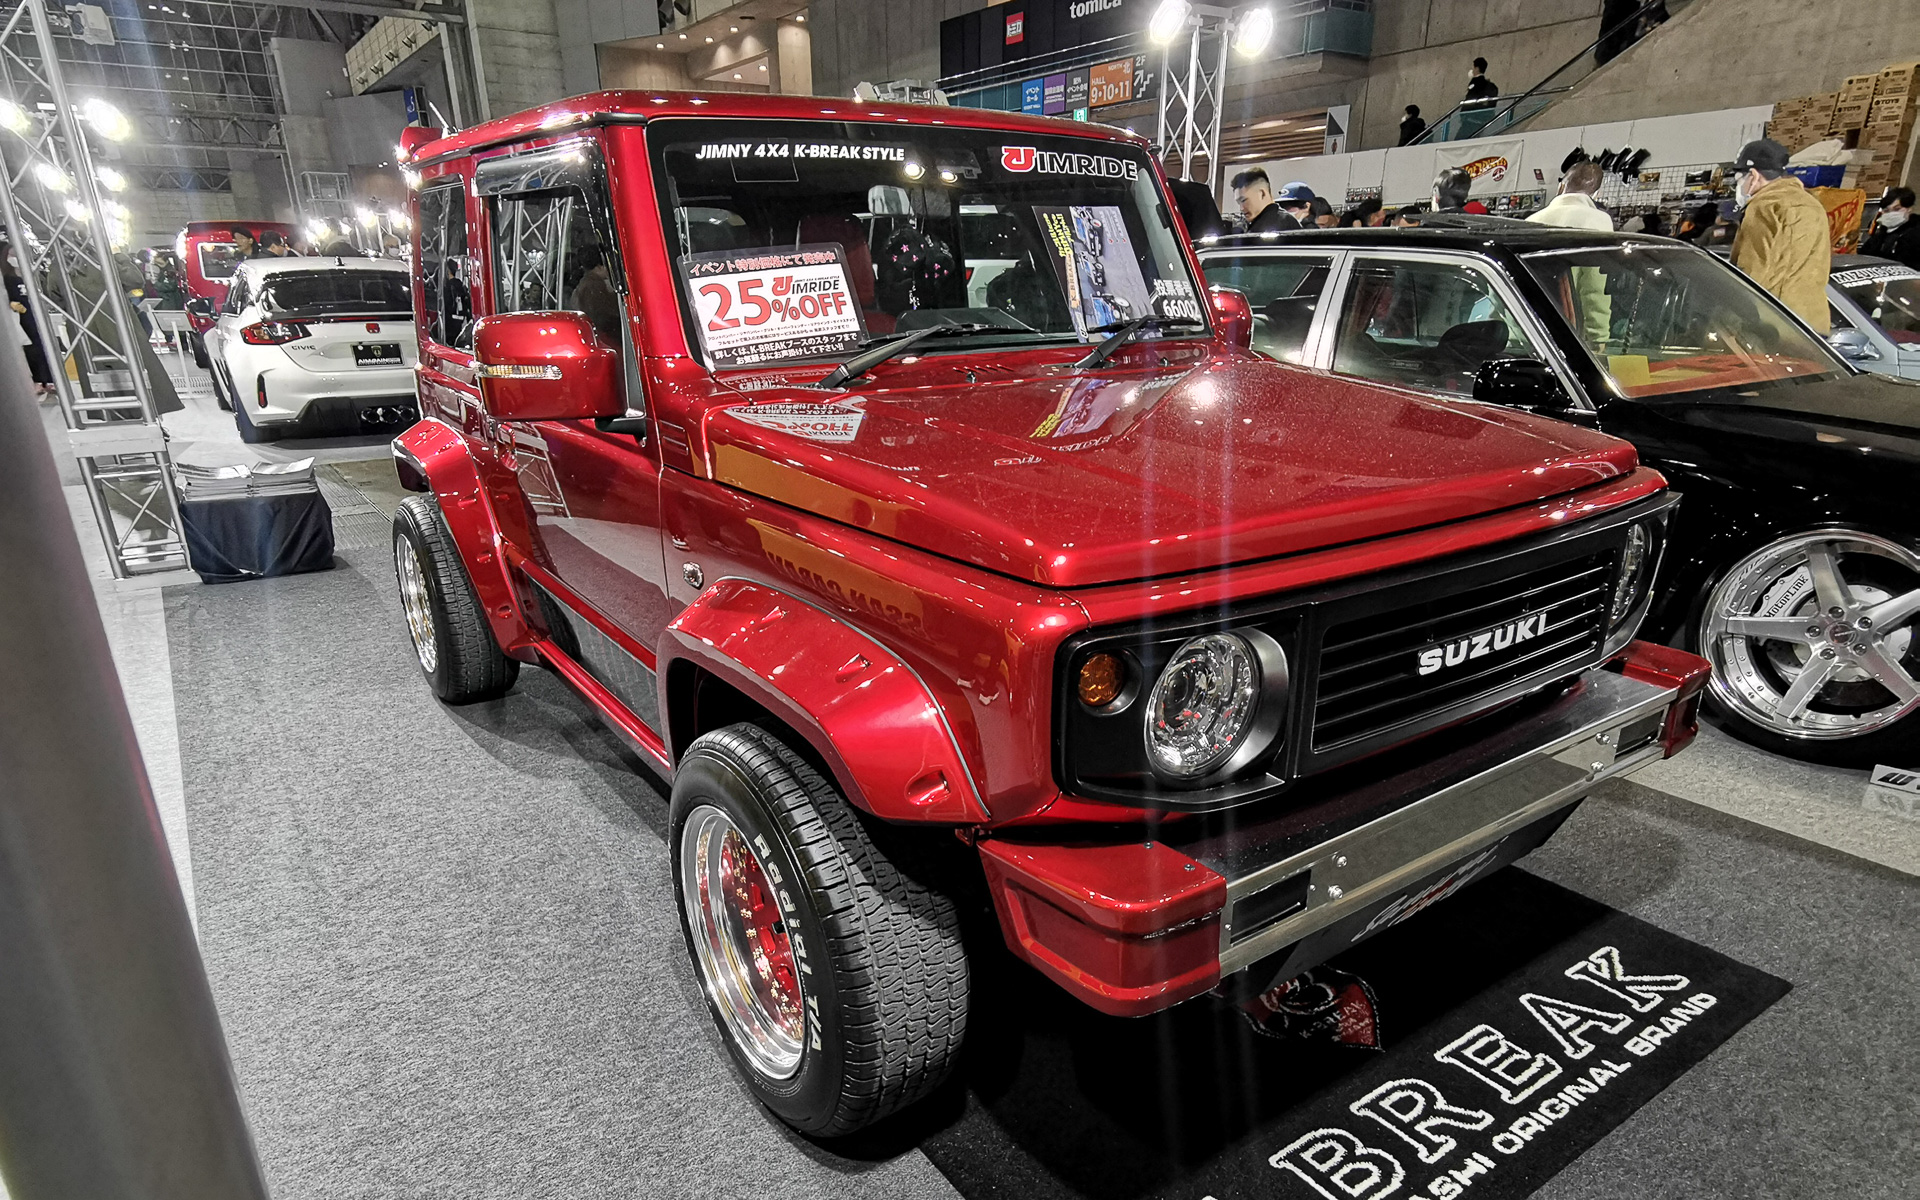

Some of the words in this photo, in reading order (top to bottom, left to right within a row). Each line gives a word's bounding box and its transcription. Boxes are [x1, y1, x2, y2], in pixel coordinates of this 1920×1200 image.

[1135, 55, 1146, 67] 2F
[1091, 76, 1106, 85] HALL
[695, 144, 752, 160] JIMNY
[754, 143, 789, 158] 4X4
[794, 144, 860, 159] K-BREAK
[862, 146, 905, 161] STYLE
[1153, 278, 1193, 297] 投票番号
[1162, 299, 1202, 321] 66002
[1418, 613, 1547, 676] SUZUKI
[754, 833, 813, 975] Radial
[808, 995, 822, 1051] T/A
[1492, 1059, 1632, 1155] ORIGINAL
[1624, 993, 1718, 1057] BRAND
